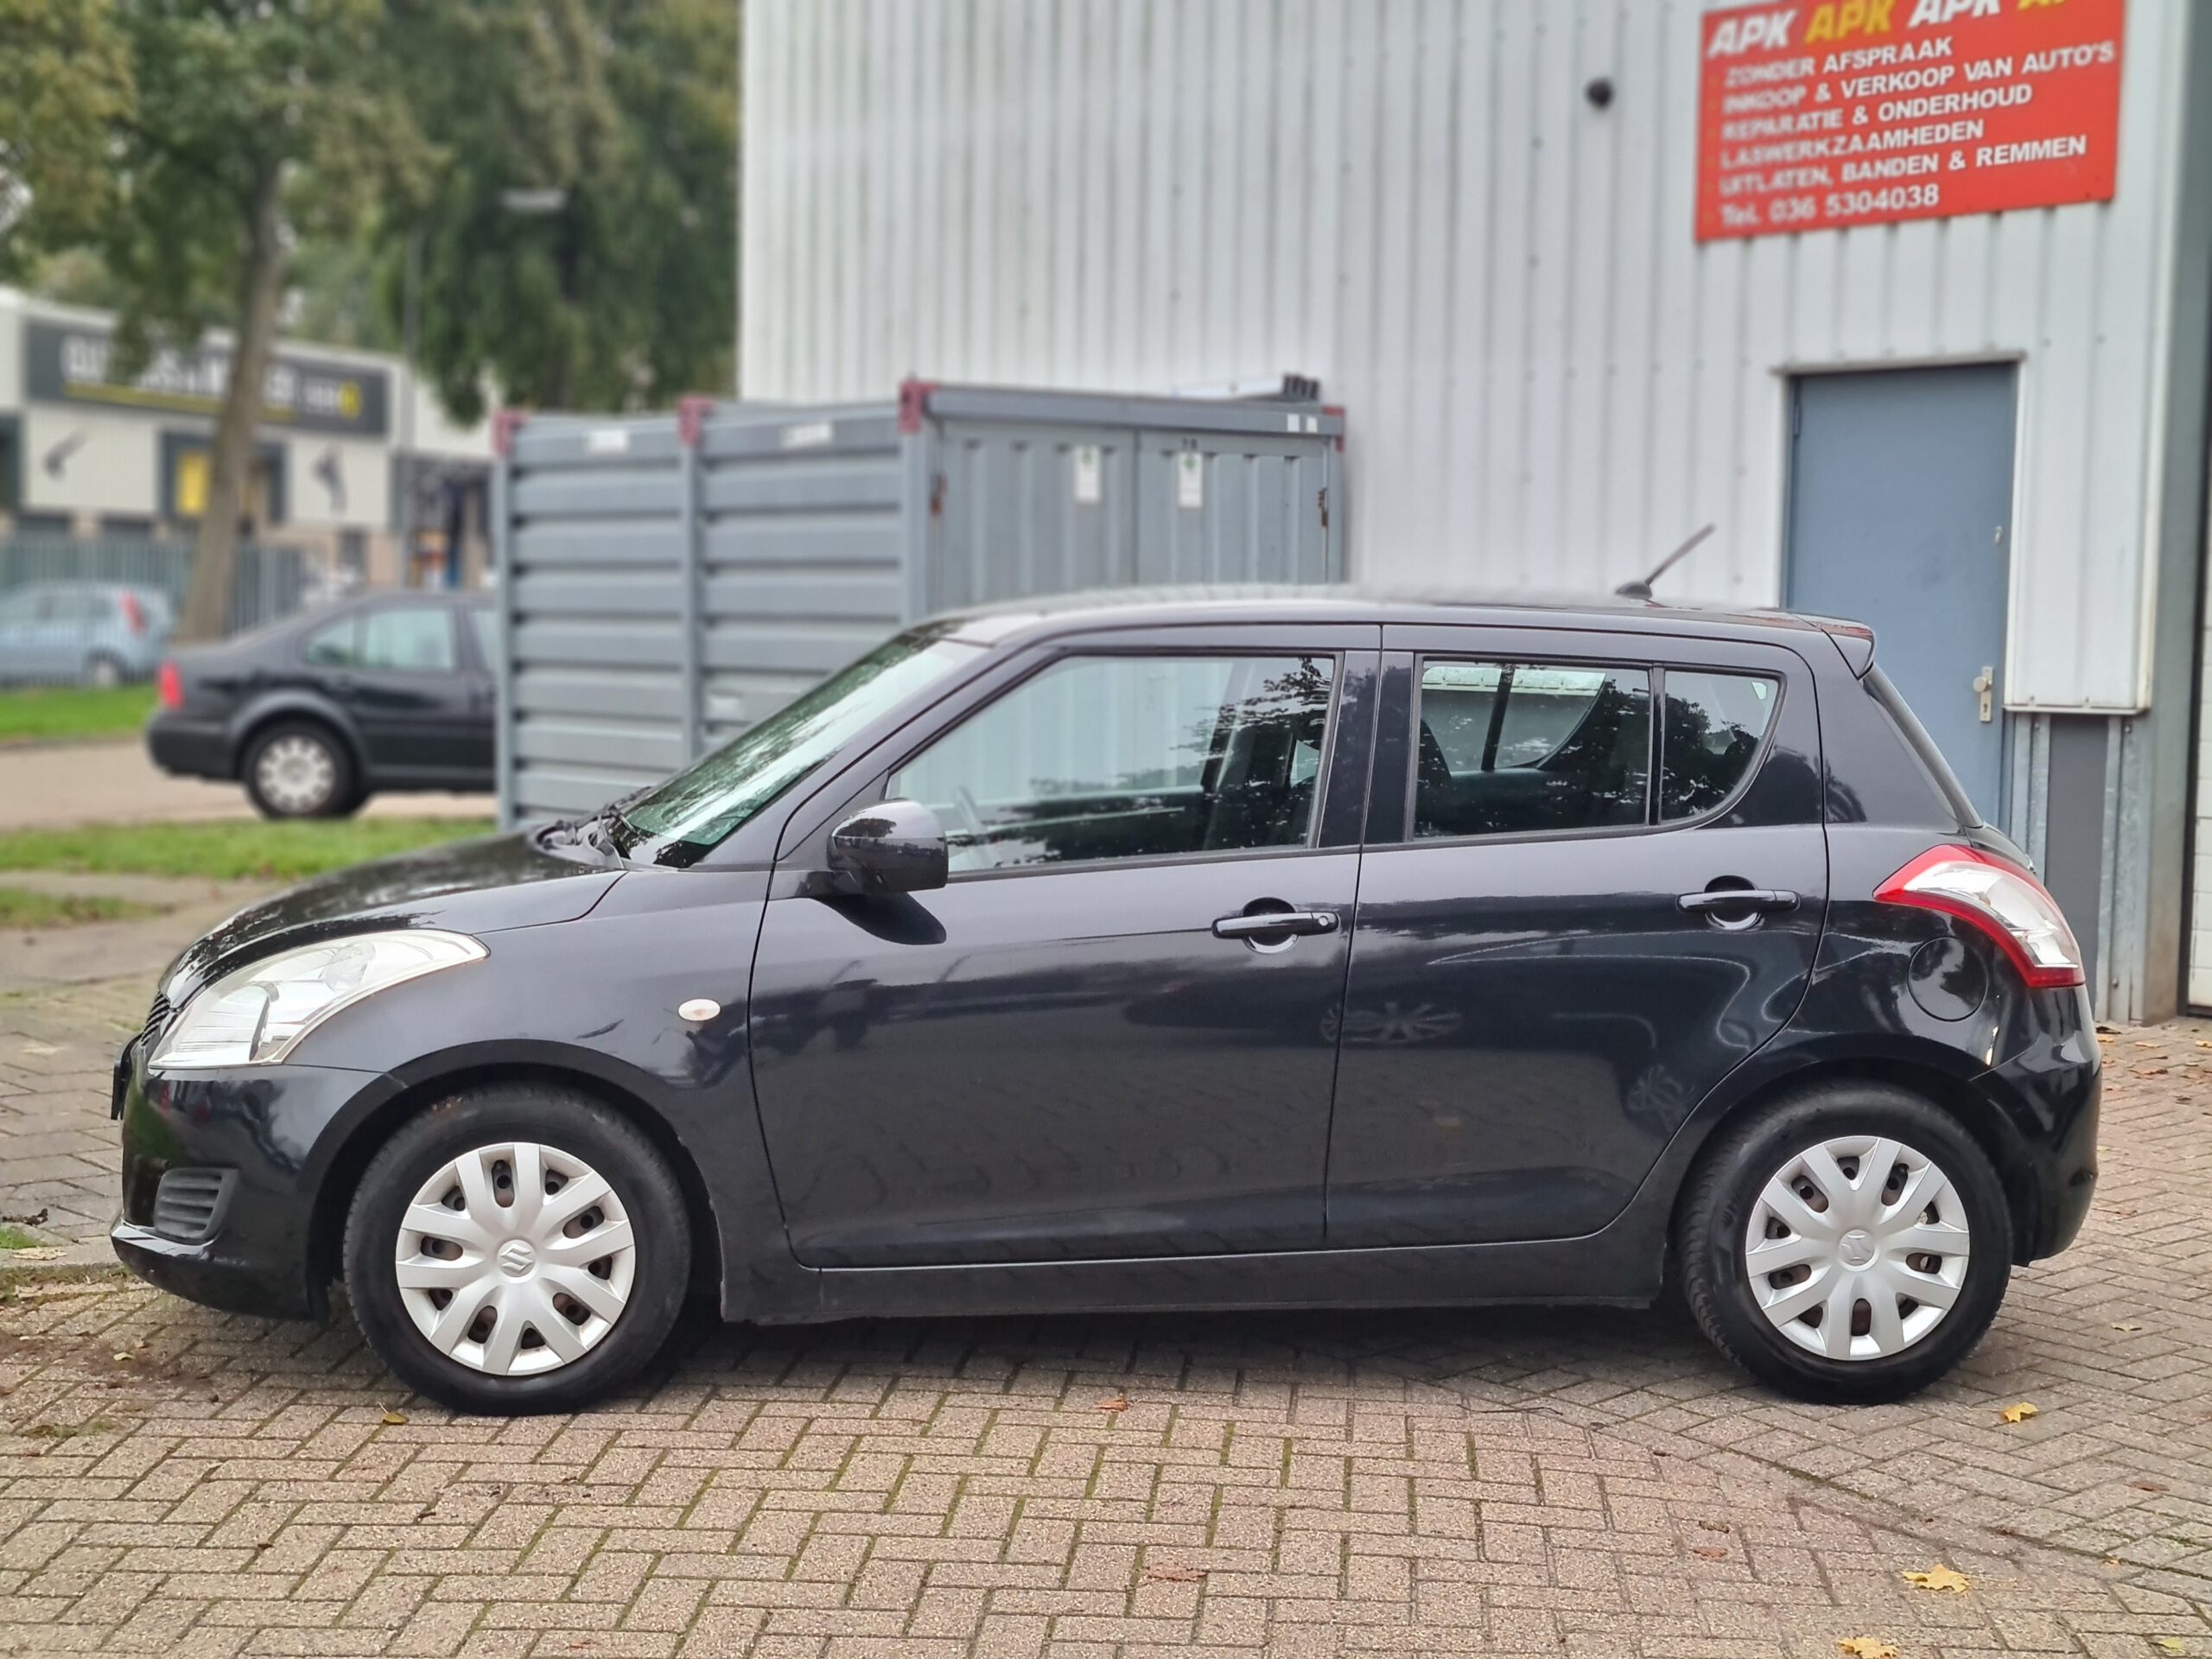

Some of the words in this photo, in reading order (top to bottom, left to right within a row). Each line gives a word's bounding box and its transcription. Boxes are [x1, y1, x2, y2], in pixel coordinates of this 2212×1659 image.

[1707, 9, 1796, 58] APK
[1804, 0, 1895, 42] APK
[1723, 85, 1807, 113] INKOOP
[1815, 83, 1831, 102] &
[1840, 65, 1955, 99] VERKOOP
[1963, 56, 2013, 81] VAN
[2021, 41, 2114, 74] AUTO'S
[1726, 56, 1815, 87] ZONDER
[1823, 36, 1953, 73] AFSPRAAK
[1722, 108, 1843, 140] REPARATIE
[1852, 105, 1869, 124] &
[1878, 84, 2032, 122] ONDERHOUD
[1719, 165, 1834, 196] UITLATEN,
[1841, 153, 1939, 182] BANDEN
[1948, 150, 1966, 170] &
[1975, 134, 2087, 167] REMMEN
[1720, 119, 1984, 169] LASWERKZAAMHEDEN
[1720, 203, 1761, 226] Tel.
[1770, 195, 1816, 223] 036
[1825, 183, 1939, 217] 5304038
